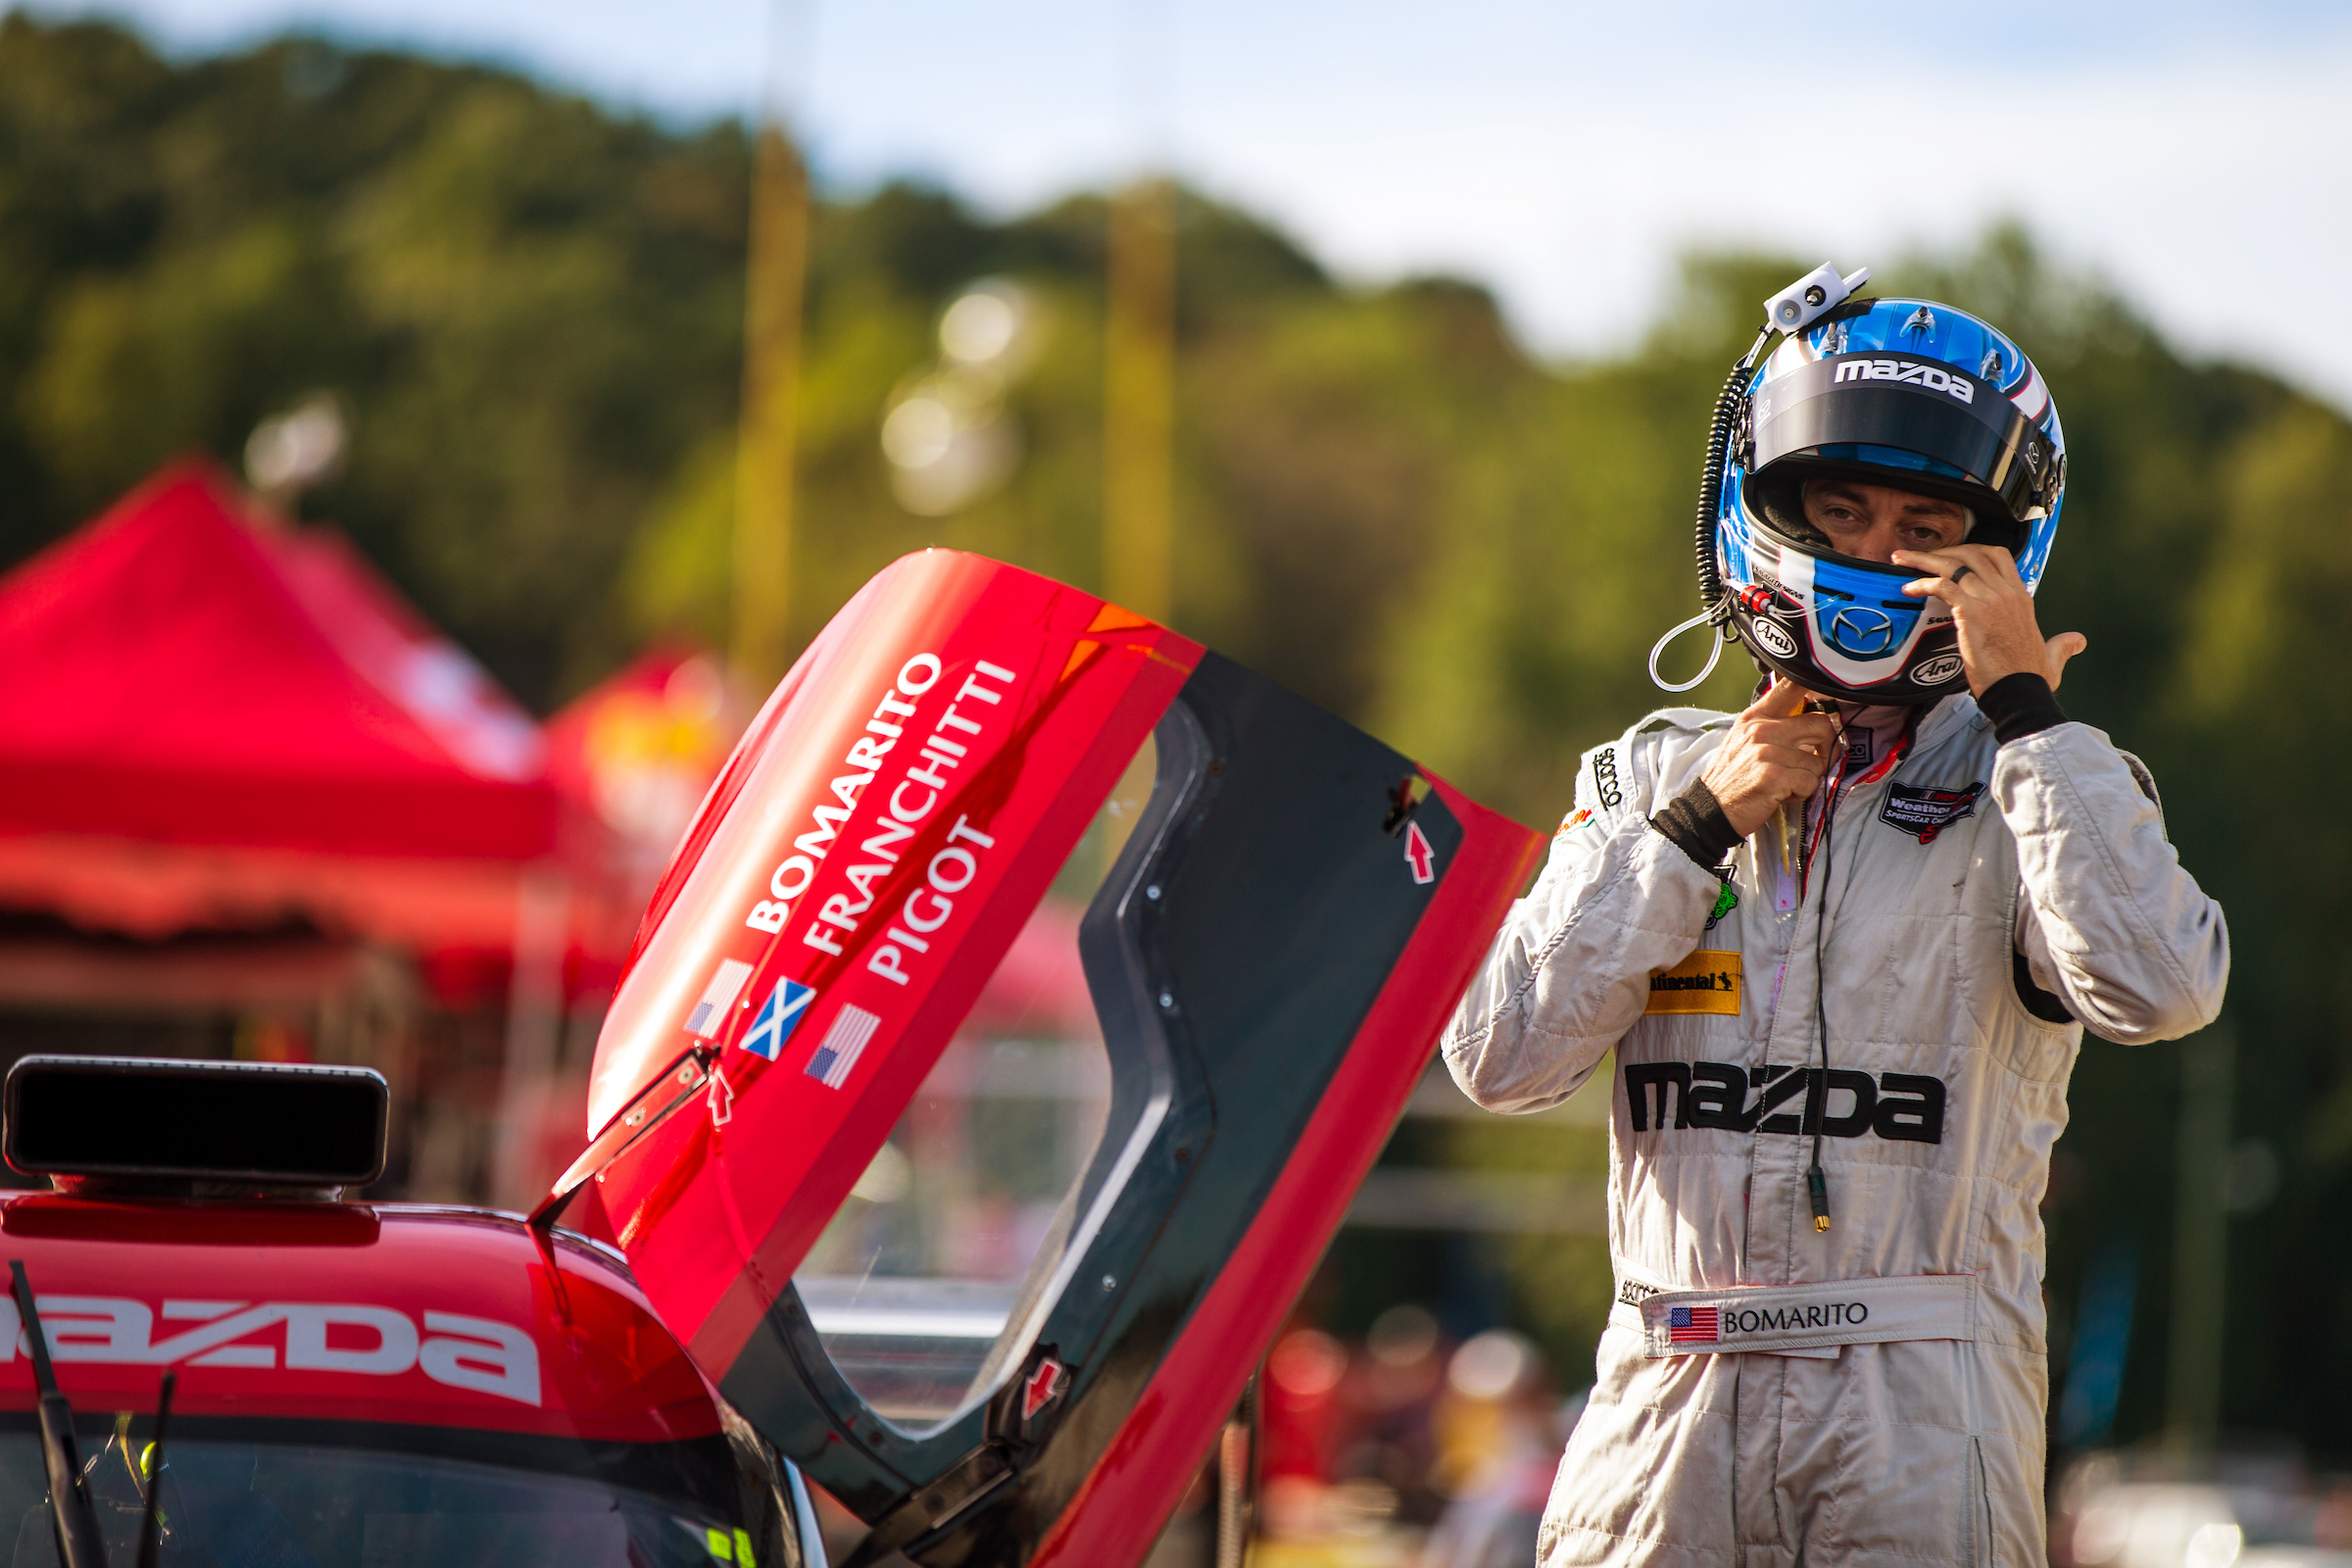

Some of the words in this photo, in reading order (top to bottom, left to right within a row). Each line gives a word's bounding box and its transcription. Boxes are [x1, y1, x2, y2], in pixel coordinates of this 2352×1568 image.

[1835, 360, 1975, 405] mazda
[1757, 624, 1790, 651] Arai
[1917, 657, 1960, 678] Arai
[746, 653, 943, 934] BOMARITO
[1593, 748, 1623, 809] sparco
[803, 660, 1017, 957] FRANCHITTI
[867, 813, 997, 987] PIGOT
[1650, 973, 1715, 991] ntinental
[1624, 1061, 1947, 1145] mazda
[1724, 1302, 1869, 1334] BOMARITO
